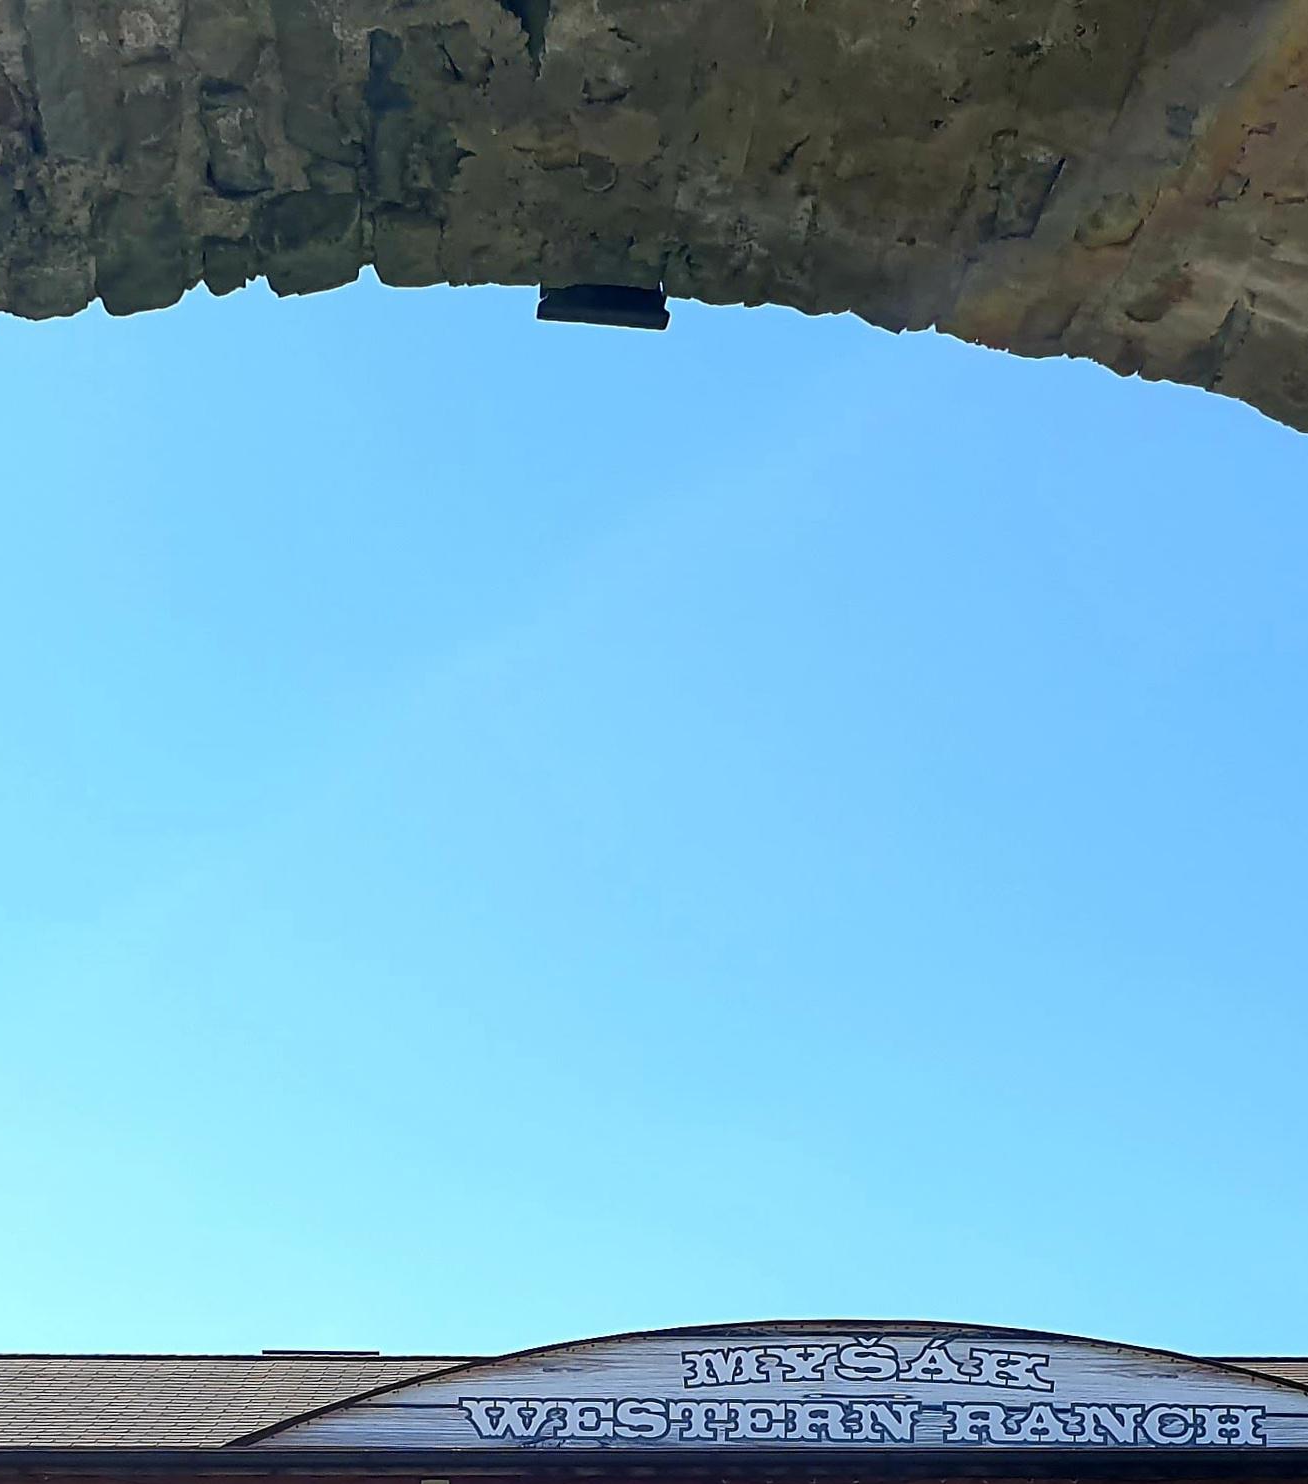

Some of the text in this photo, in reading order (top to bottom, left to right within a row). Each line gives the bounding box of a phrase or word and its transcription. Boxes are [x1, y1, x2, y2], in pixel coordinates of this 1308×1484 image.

[682, 1338, 1055, 1392] MYŠÁK
[459, 1397, 1268, 1446] WESTERN RANCH
